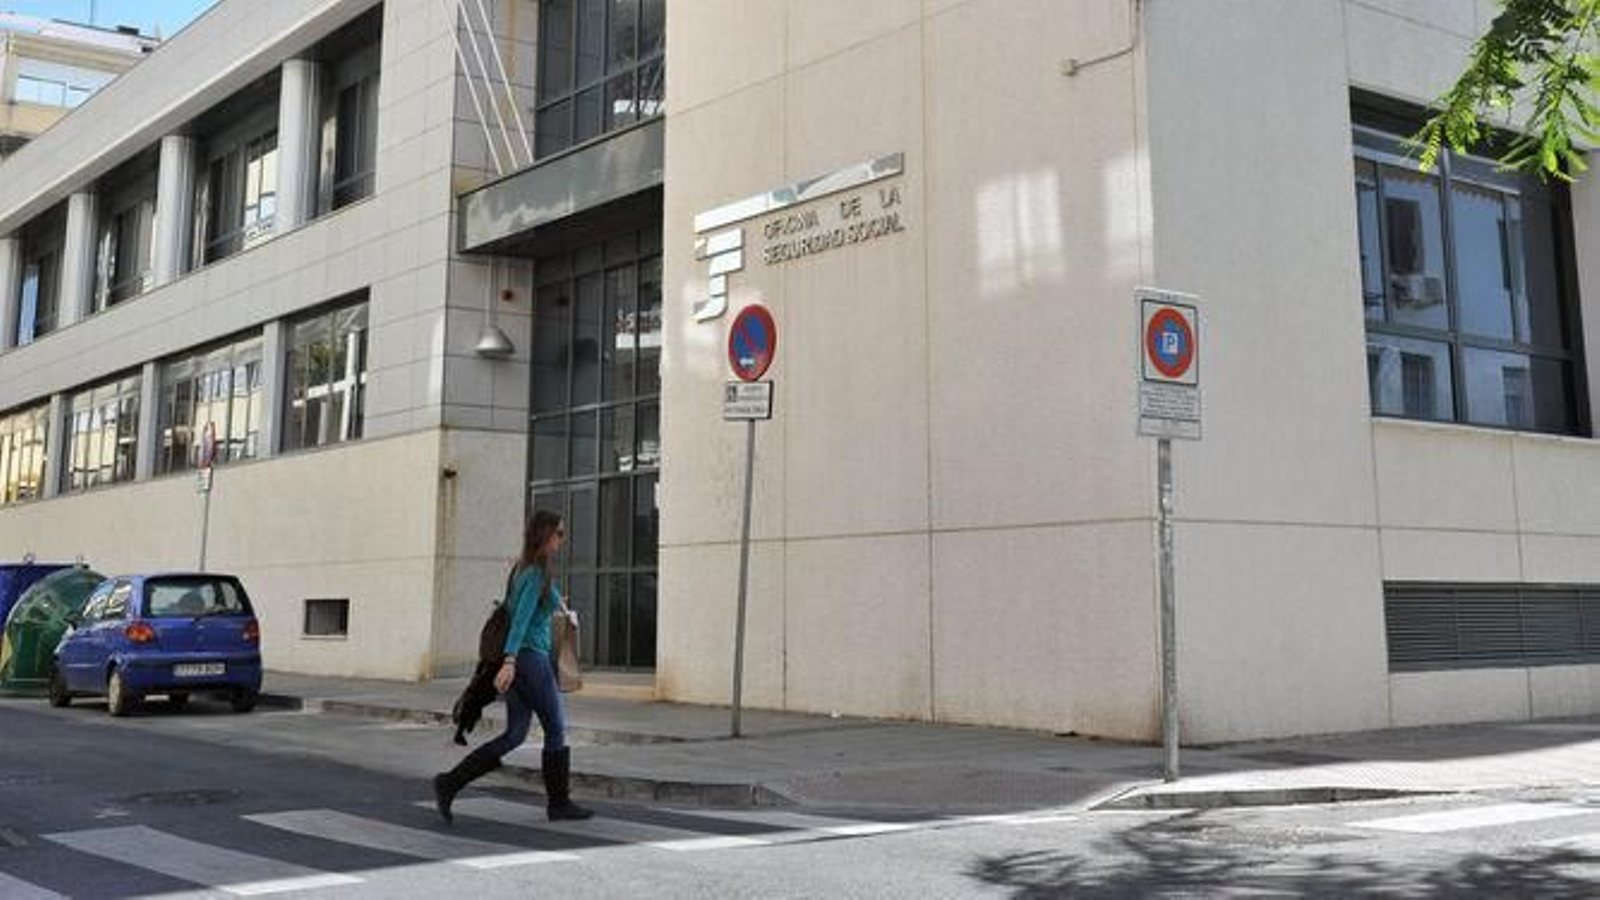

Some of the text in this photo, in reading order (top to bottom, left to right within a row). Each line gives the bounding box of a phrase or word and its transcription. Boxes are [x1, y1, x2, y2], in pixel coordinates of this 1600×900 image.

[763, 212, 906, 265] SEGURIDAD SOCIAL
[764, 187, 902, 241] OFICINA DE LA
